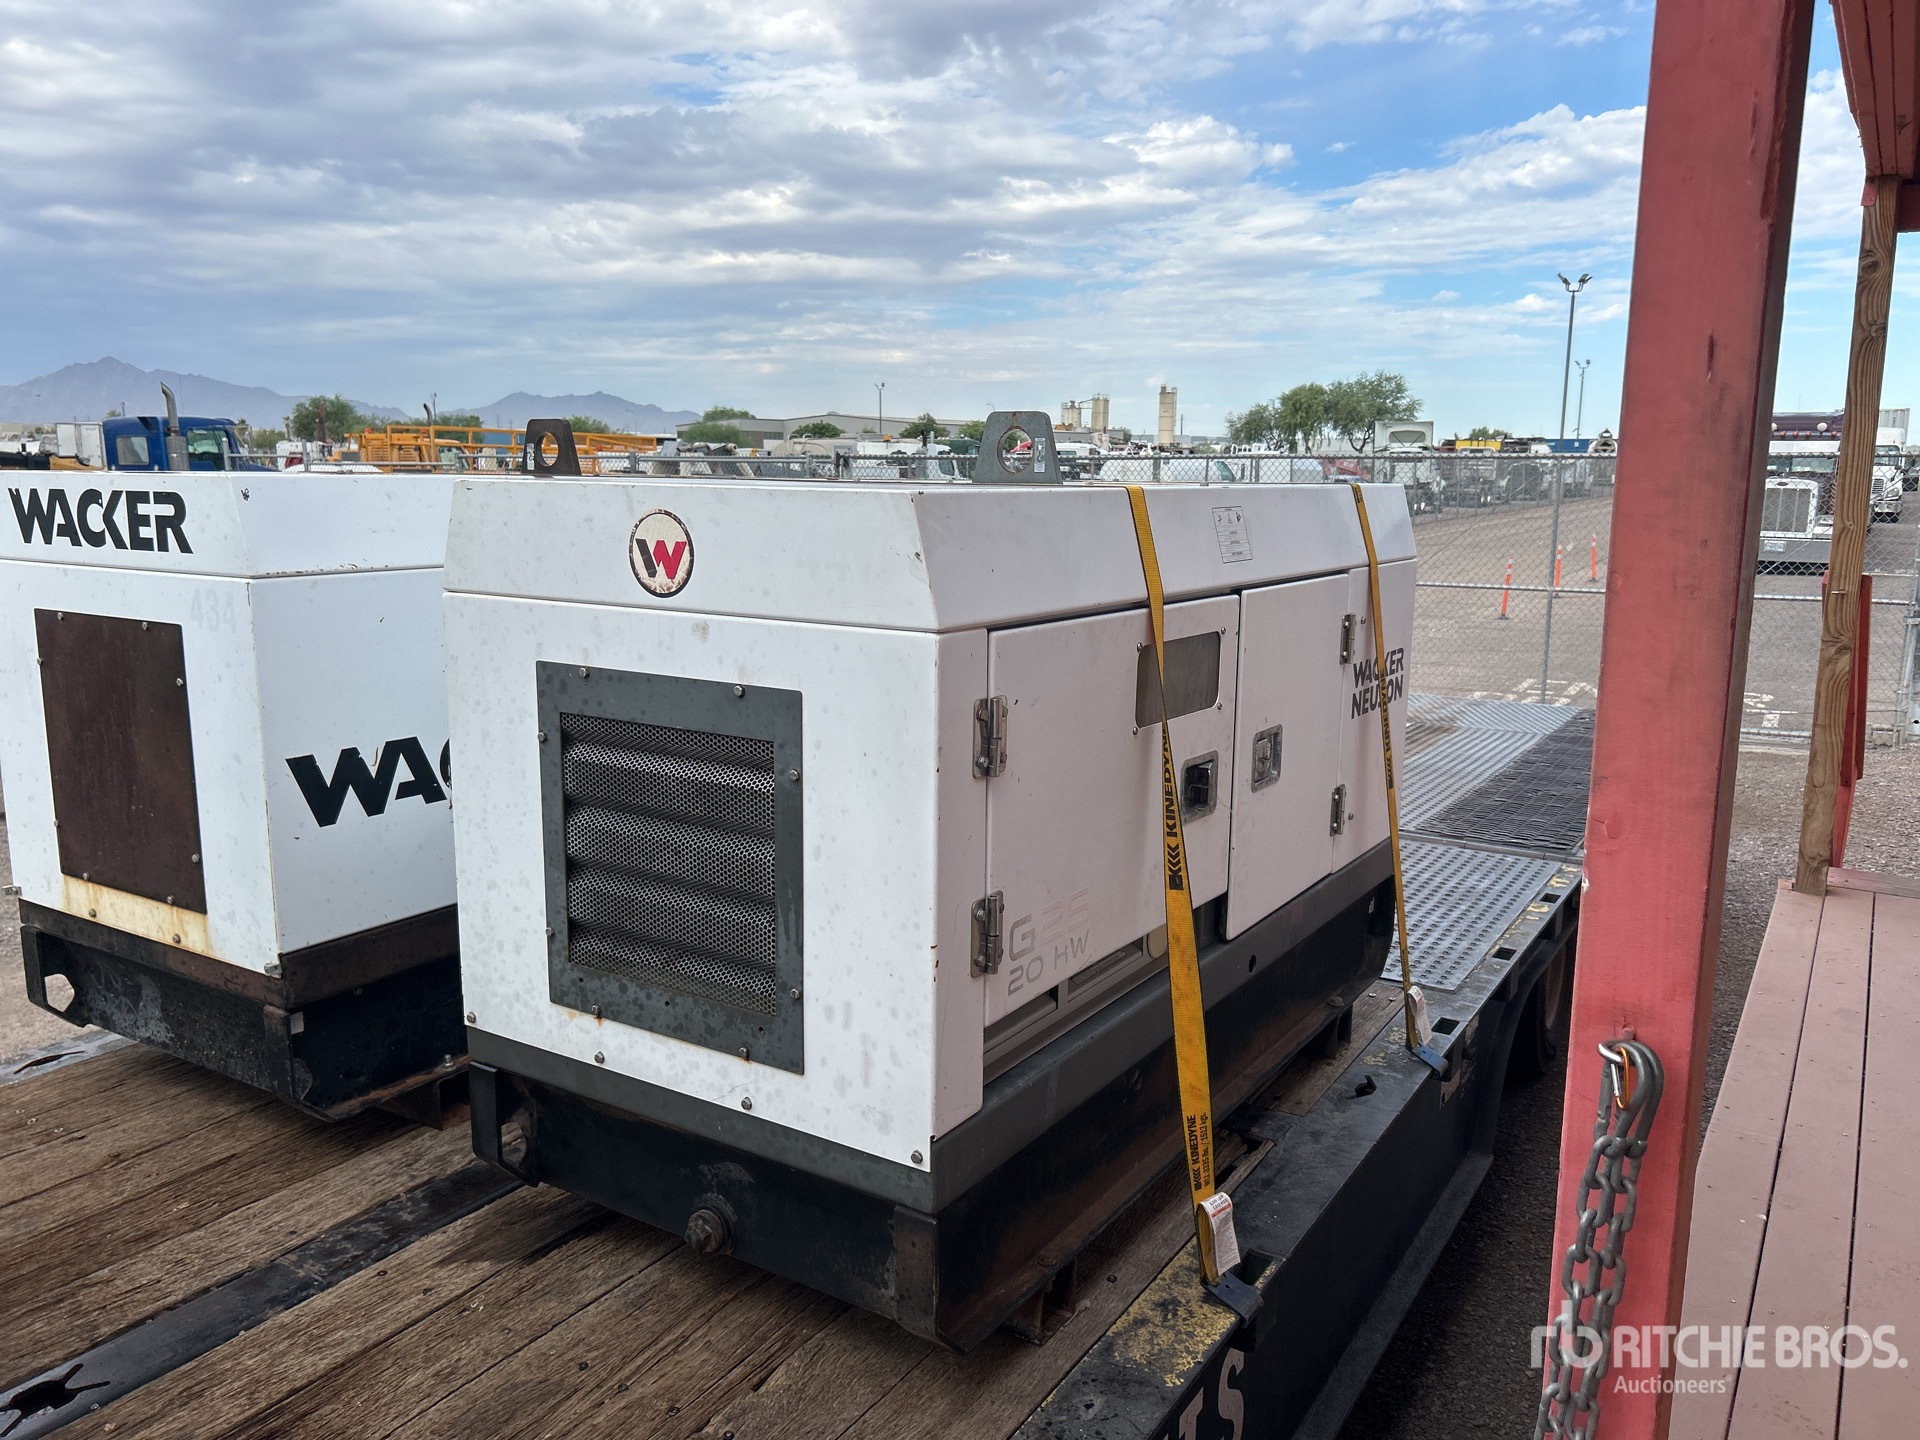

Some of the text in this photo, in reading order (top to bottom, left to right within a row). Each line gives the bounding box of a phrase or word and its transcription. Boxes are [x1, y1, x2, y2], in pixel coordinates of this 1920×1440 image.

[8, 487, 194, 554] WACKER
[1351, 674, 1404, 719] NEUON
[285, 736, 452, 827] WA
[1009, 887, 1089, 962] G25
[1008, 954, 1043, 996] 20
[1187, 1114, 1200, 1165] KINEDYNE
